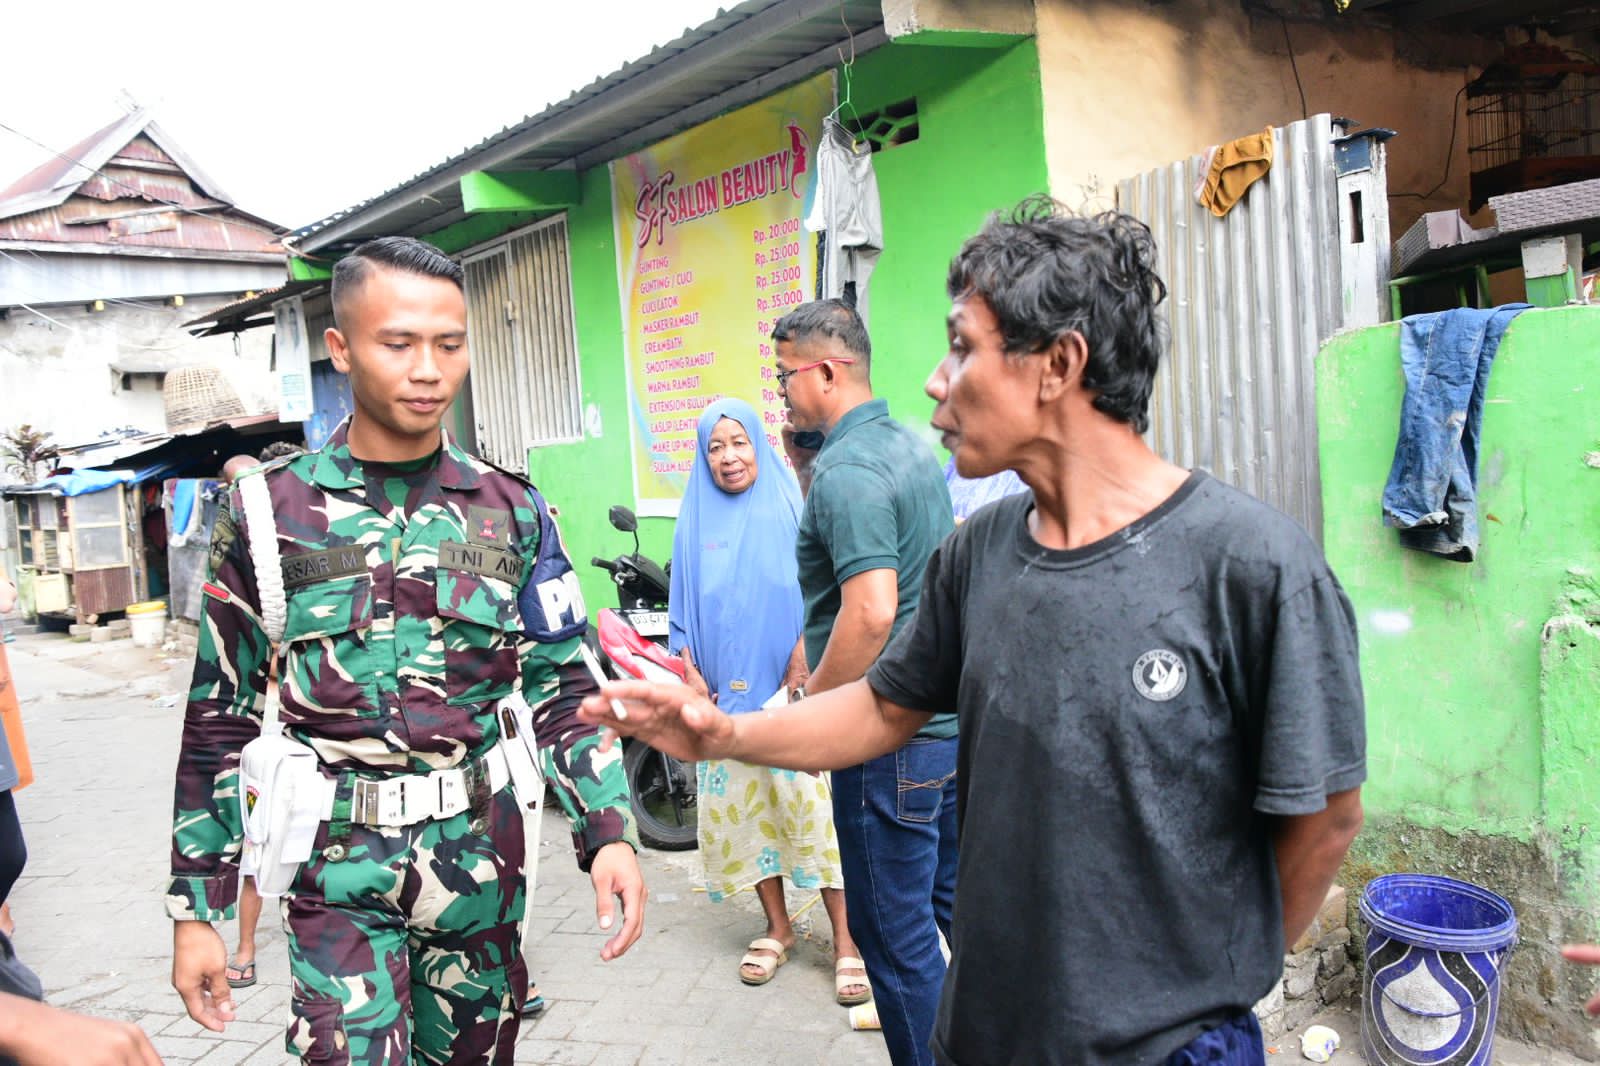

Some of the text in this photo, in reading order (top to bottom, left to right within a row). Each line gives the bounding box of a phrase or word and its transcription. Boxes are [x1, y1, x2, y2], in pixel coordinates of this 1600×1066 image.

[668, 176, 719, 224] SALON
[722, 151, 791, 209] BEAUTY
[640, 256, 669, 274] GUNTING
[641, 276, 670, 294] GUNTING
[677, 271, 693, 286] CUCI
[672, 375, 700, 390] RAMBUT
[341, 551, 357, 570] M
[447, 548, 483, 567] TNI
